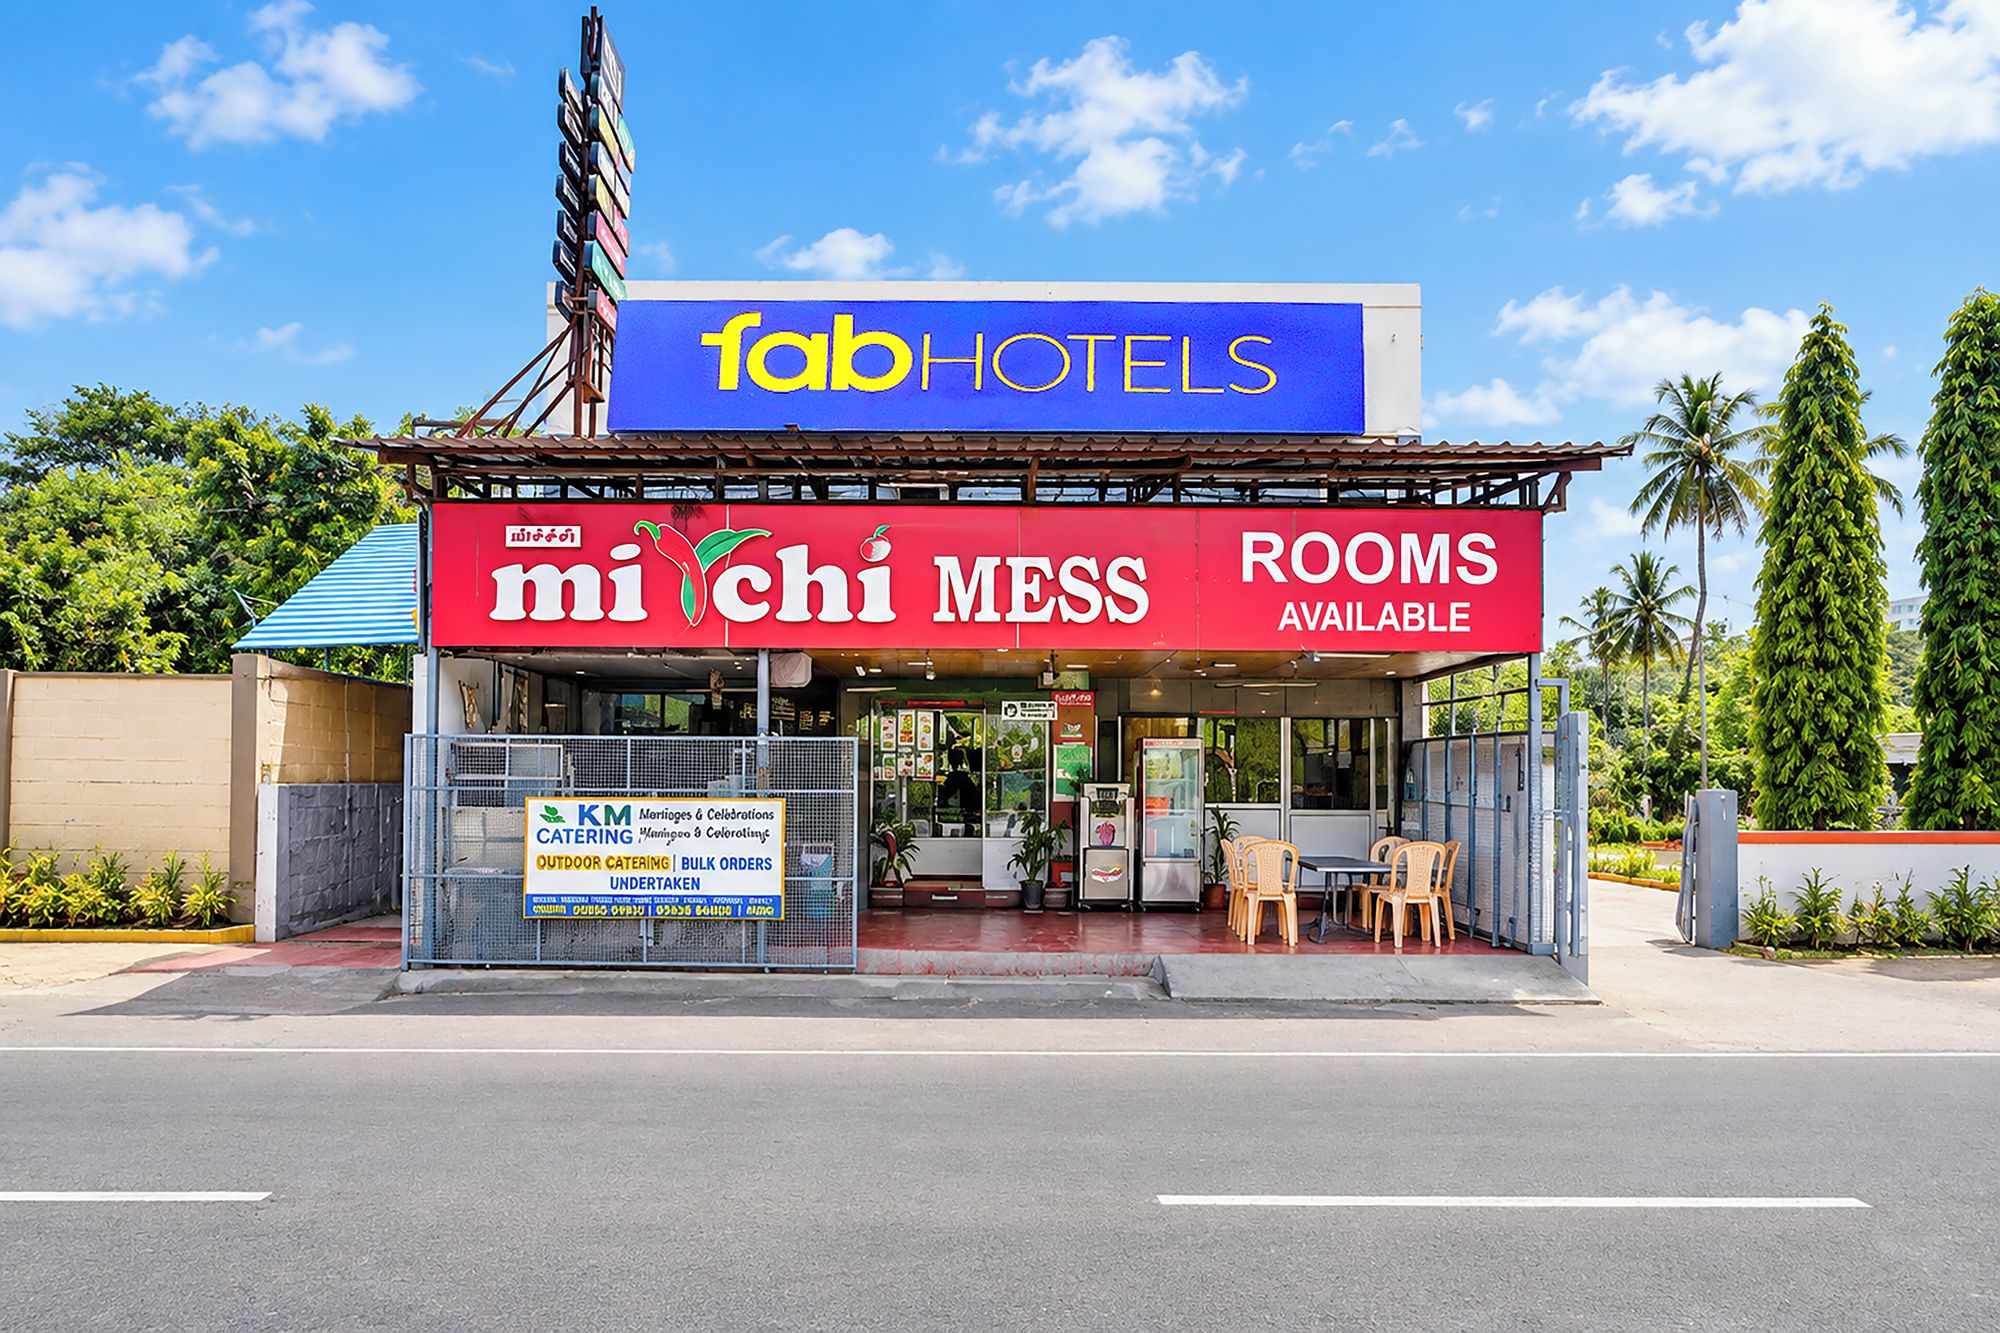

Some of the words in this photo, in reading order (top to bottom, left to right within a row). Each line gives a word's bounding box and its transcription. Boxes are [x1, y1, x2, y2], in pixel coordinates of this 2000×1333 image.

[1242, 532, 1498, 585] ROOMS
[933, 556, 1149, 624] MESS
[1277, 602, 1471, 632] AVAILABLE
[578, 805, 631, 826] KM
[537, 828, 633, 845] CATERING
[536, 854, 601, 870] OUTDOOR
[681, 856, 716, 871] BULK
[719, 856, 773, 871] ORDERS
[610, 876, 701, 891] UNDERTAKEN
